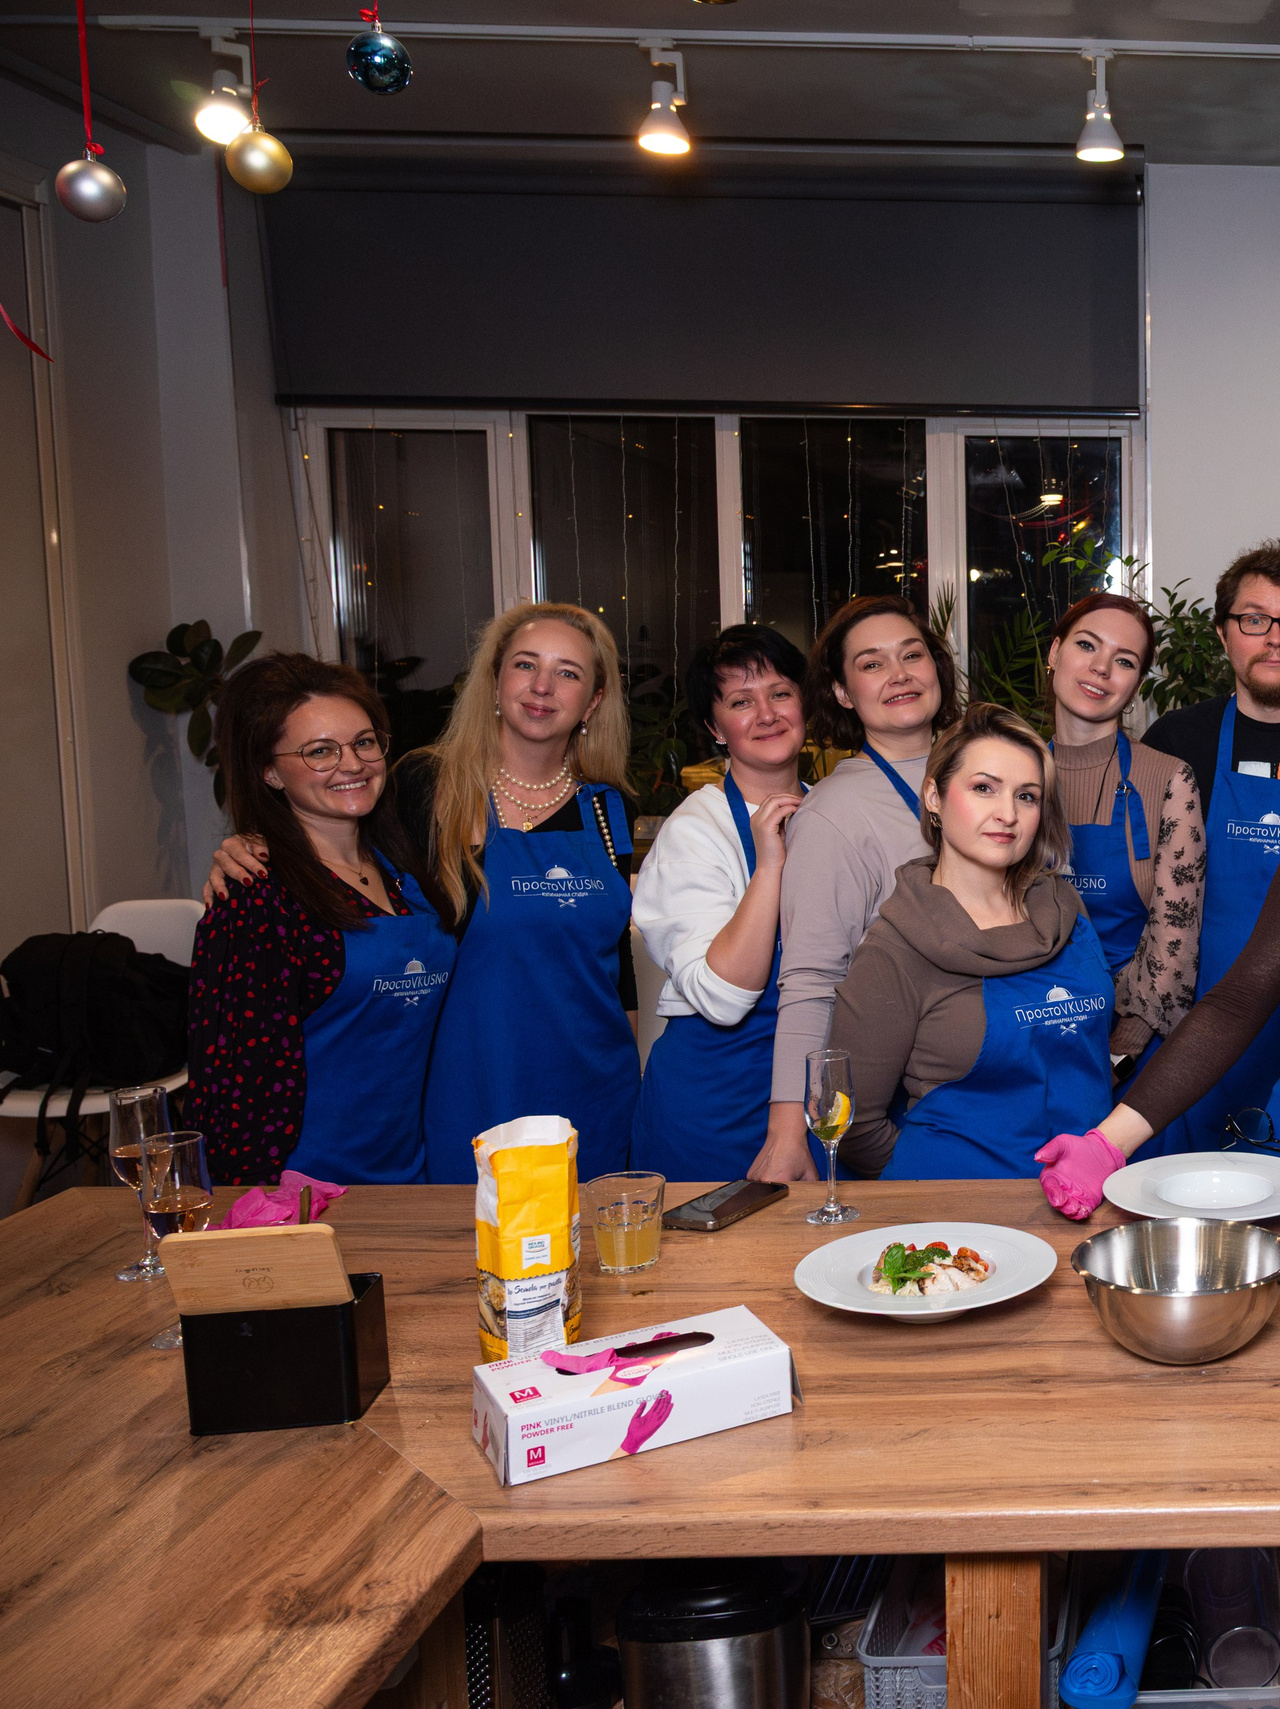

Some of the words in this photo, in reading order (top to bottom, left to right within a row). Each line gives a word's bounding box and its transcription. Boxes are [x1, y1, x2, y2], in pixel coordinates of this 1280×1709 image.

[511, 879, 605, 893] ПростоVKUSNO
[373, 972, 449, 994] ПростоVKUSNO
[1015, 996, 1106, 1023] ПростоVKUSNO
[514, 1388, 534, 1398] M
[520, 1421, 542, 1432] PINK
[544, 1406, 604, 1426] VINYL/NITRILE
[607, 1399, 634, 1412] BLEND
[636, 1392, 667, 1405] GLOVES
[522, 1428, 554, 1440] POWDER
[556, 1422, 574, 1432] FREE
[530, 1448, 542, 1460] M
